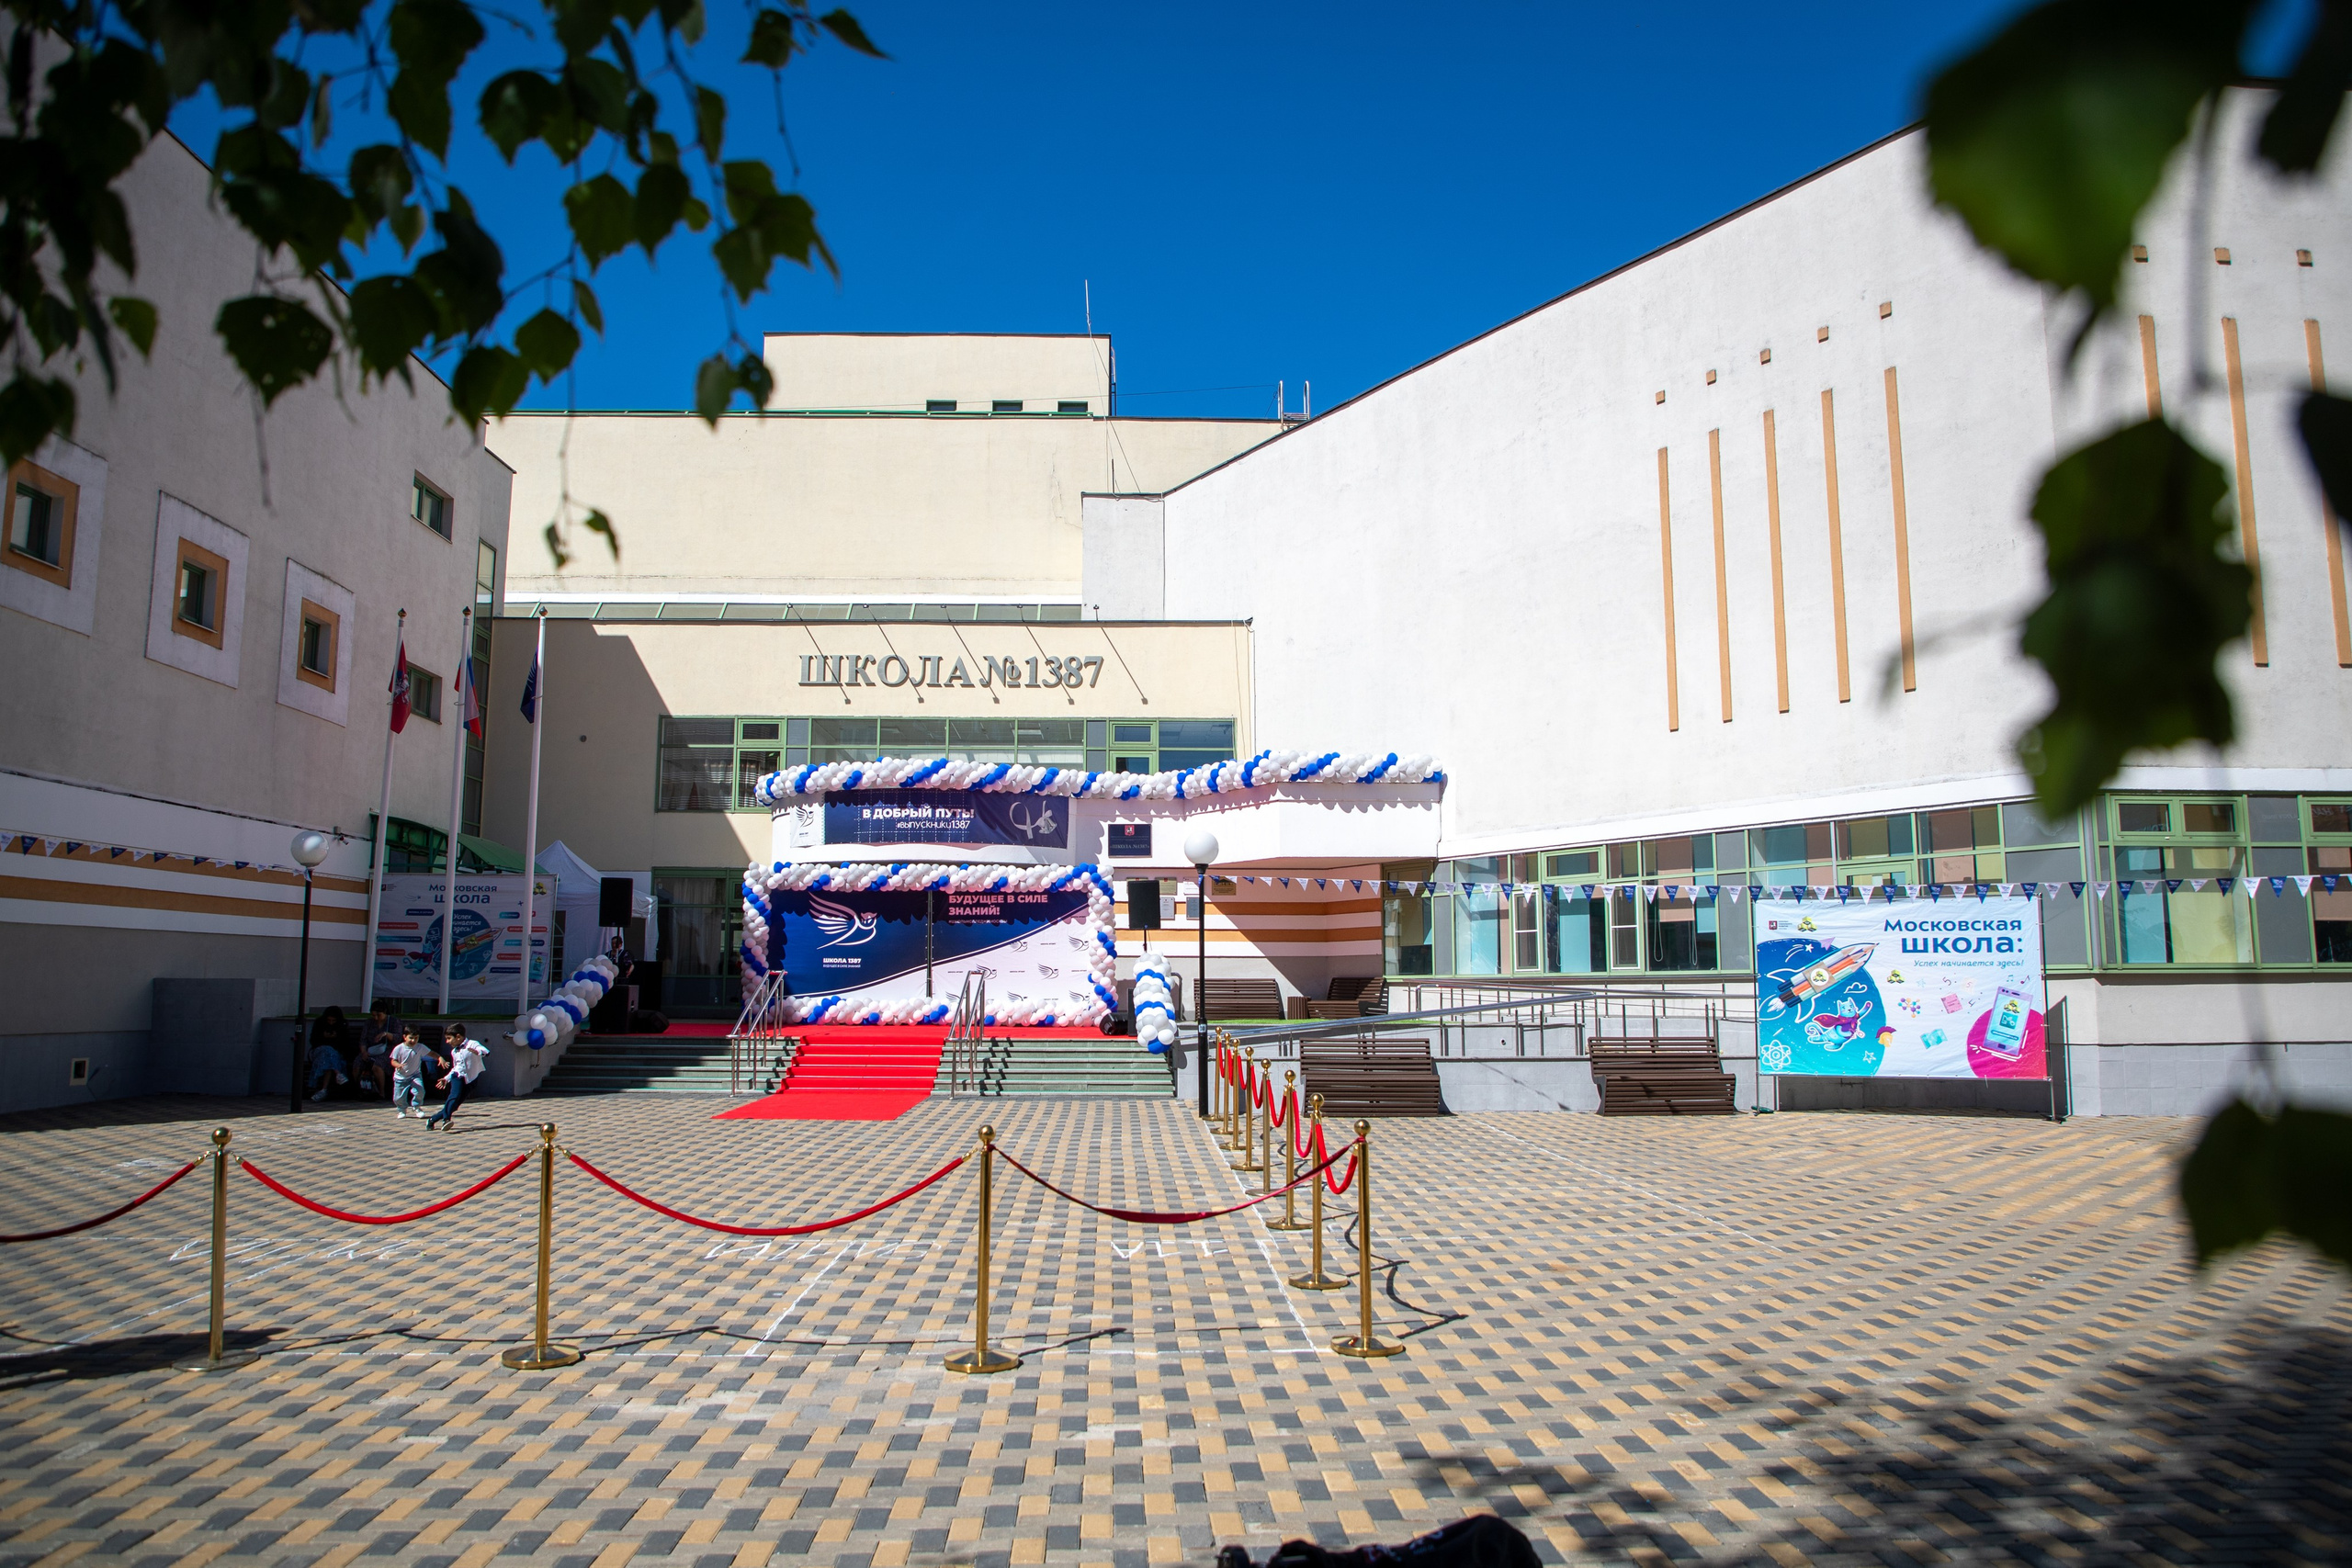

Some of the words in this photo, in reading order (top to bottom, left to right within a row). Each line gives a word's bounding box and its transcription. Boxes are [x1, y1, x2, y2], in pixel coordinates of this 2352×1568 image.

[798, 654, 975, 688] ШКОЛА
[978, 654, 1105, 689] №1387
[862, 808, 872, 818] В
[873, 806, 933, 820] ДОБРЫЙ
[935, 807, 975, 818] ПУТЬ!
[428, 884, 498, 892] Моковская
[948, 895, 1005, 905] БУДУЩЕЕ
[1007, 895, 1015, 903] В
[1017, 895, 1048, 904] СИЛЕ
[948, 905, 1001, 916] ЗНАНИЙ!
[1883, 918, 2022, 932] Московская
[1901, 936, 2024, 953] школа:
[1913, 959, 1939, 967] Успех
[1996, 959, 2025, 969] здесь!
